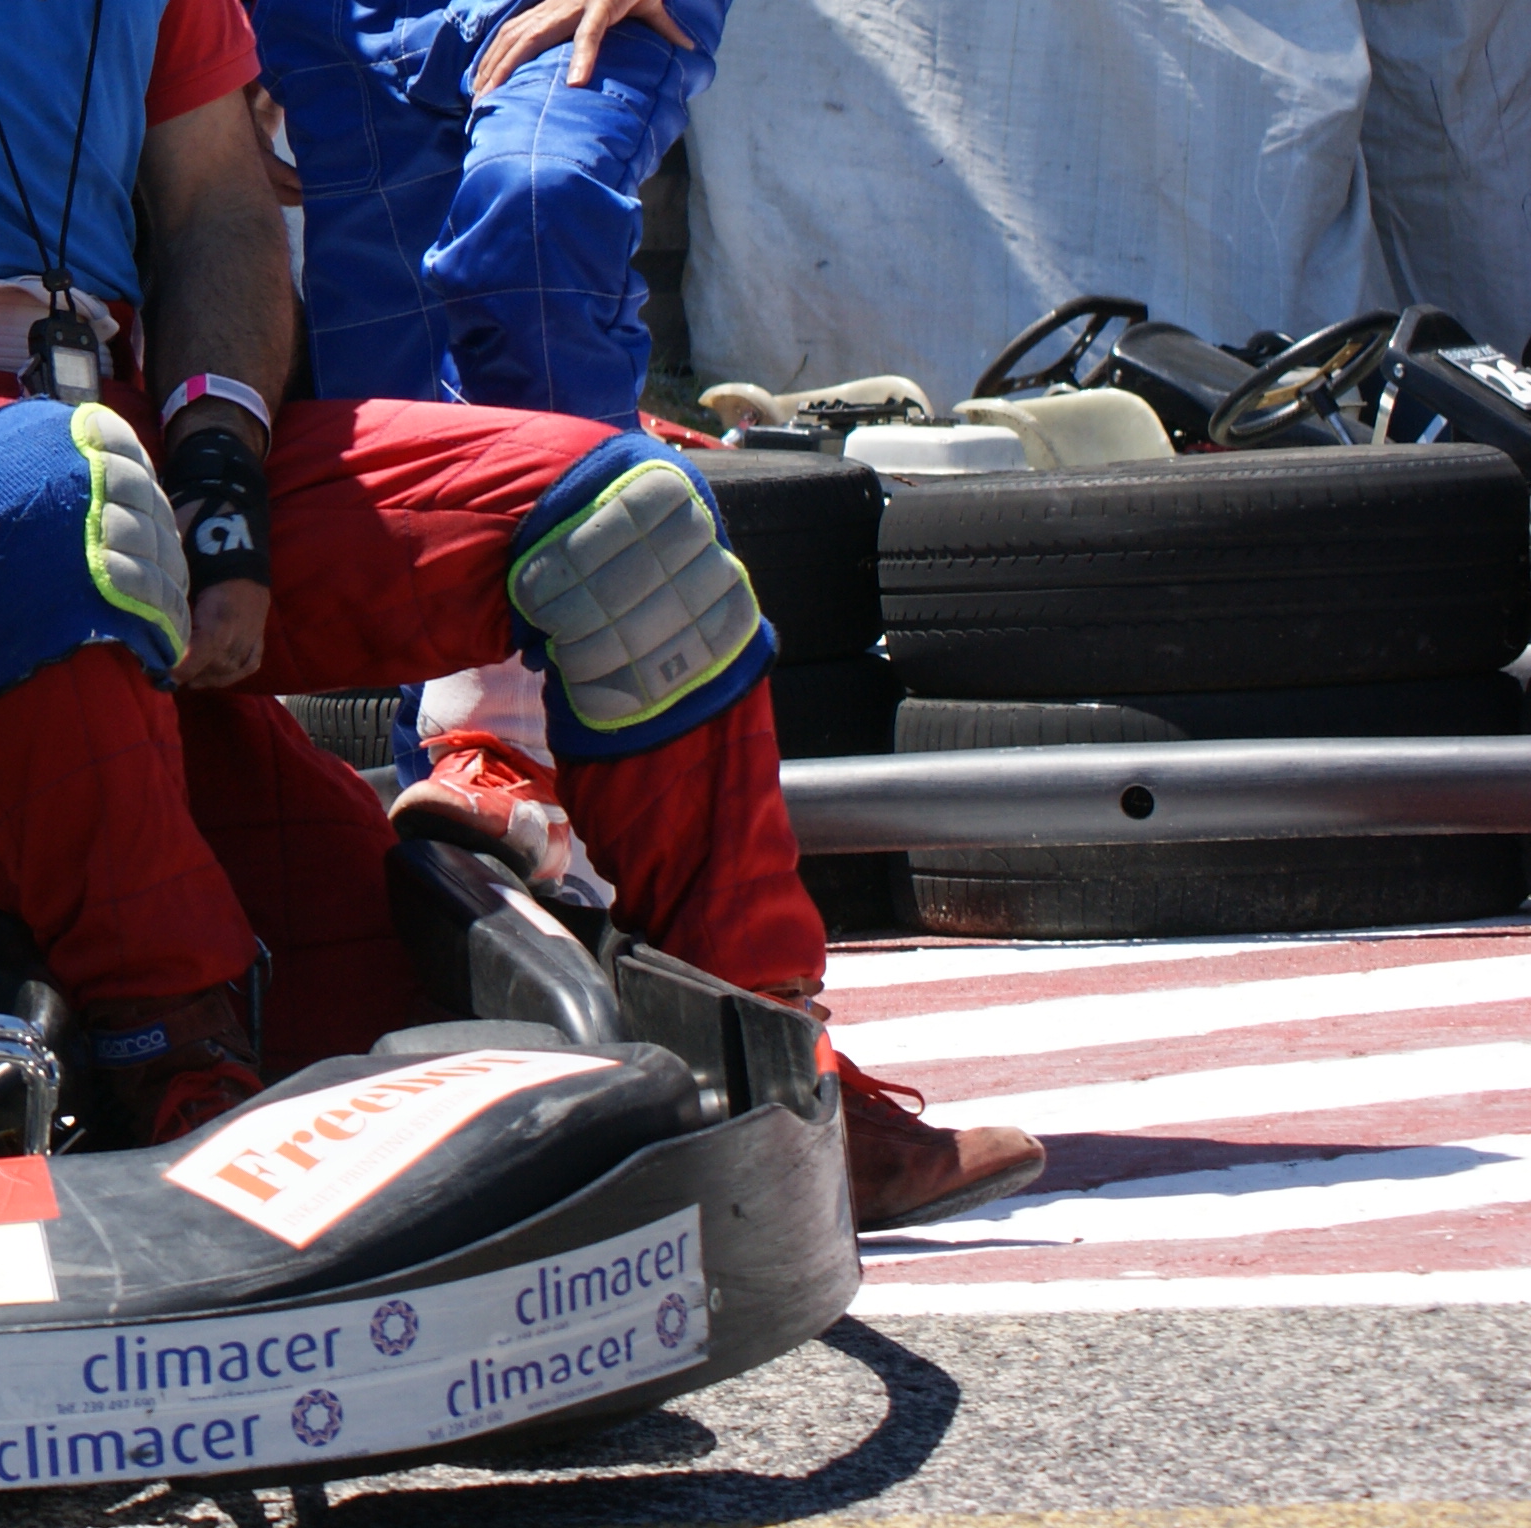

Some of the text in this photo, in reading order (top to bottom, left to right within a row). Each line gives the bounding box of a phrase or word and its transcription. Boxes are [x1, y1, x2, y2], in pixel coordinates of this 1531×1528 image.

[516, 1232, 688, 1325] climacer
[83, 1327, 341, 1394] climacer
[447, 1327, 636, 1418] climacer
[82, 1401, 104, 1414] 239
[108, 1398, 129, 1411] 497
